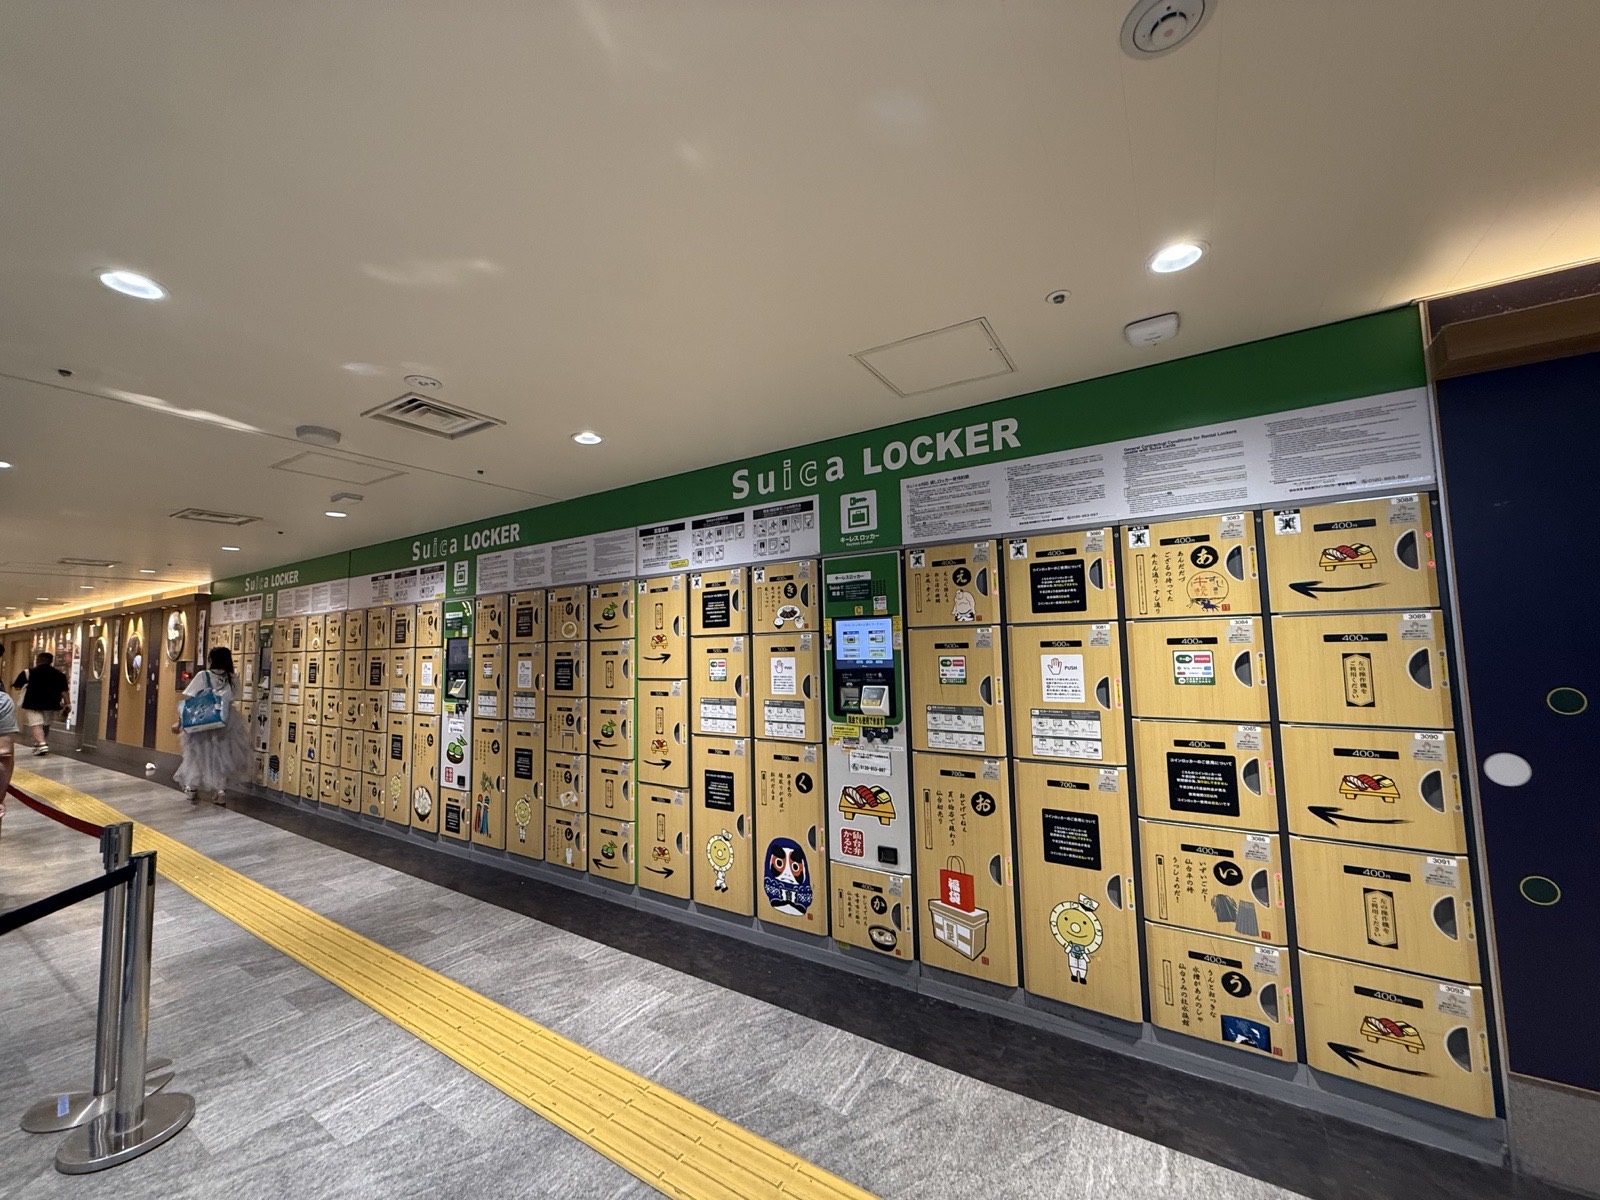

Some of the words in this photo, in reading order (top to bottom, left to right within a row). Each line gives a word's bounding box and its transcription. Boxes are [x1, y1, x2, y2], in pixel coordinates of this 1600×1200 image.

[732, 456, 845, 500] Suica
[863, 417, 1021, 475] LOCKER
[1331, 521, 1358, 530] 400円
[412, 537, 457, 561] Suica
[464, 523, 520, 552] LOCKER
[840, 533, 879, 543] キーレスロッカー
[245, 575, 269, 592] Suica
[271, 570, 299, 587] LOCKER
[1342, 634, 1369, 642] 400円
[1349, 660, 1359, 699] ご利用ください
[1358, 661, 1367, 694] 左の操作機を
[1170, 757, 1233, 766] コインロッカーのご使用について
[1352, 749, 1380, 758] 400円
[1059, 781, 1077, 789] 700円
[936, 790, 944, 825] 仙台初売り
[843, 830, 852, 853] かるた
[852, 831, 862, 855] 仙台弁
[1196, 846, 1219, 856] 400円
[1433, 857, 1452, 865] 3091
[1185, 858, 1194, 894] 仙台平の袴
[1362, 867, 1391, 879] 400円
[948, 877, 961, 905] 福袋
[1371, 896, 1381, 937] ご利用ください
[1380, 898, 1390, 935] 左の操作機を
[1204, 955, 1227, 965] 400円
[1260, 947, 1275, 955] 3087
[1178, 963, 1190, 1027] 仙台うみの杜水族館
[1192, 966, 1204, 1023] 水槽があんのしゃ
[1208, 969, 1217, 1018] うんとおっきな
[1373, 990, 1402, 1003] 400円
[1446, 986, 1465, 994] 3092
